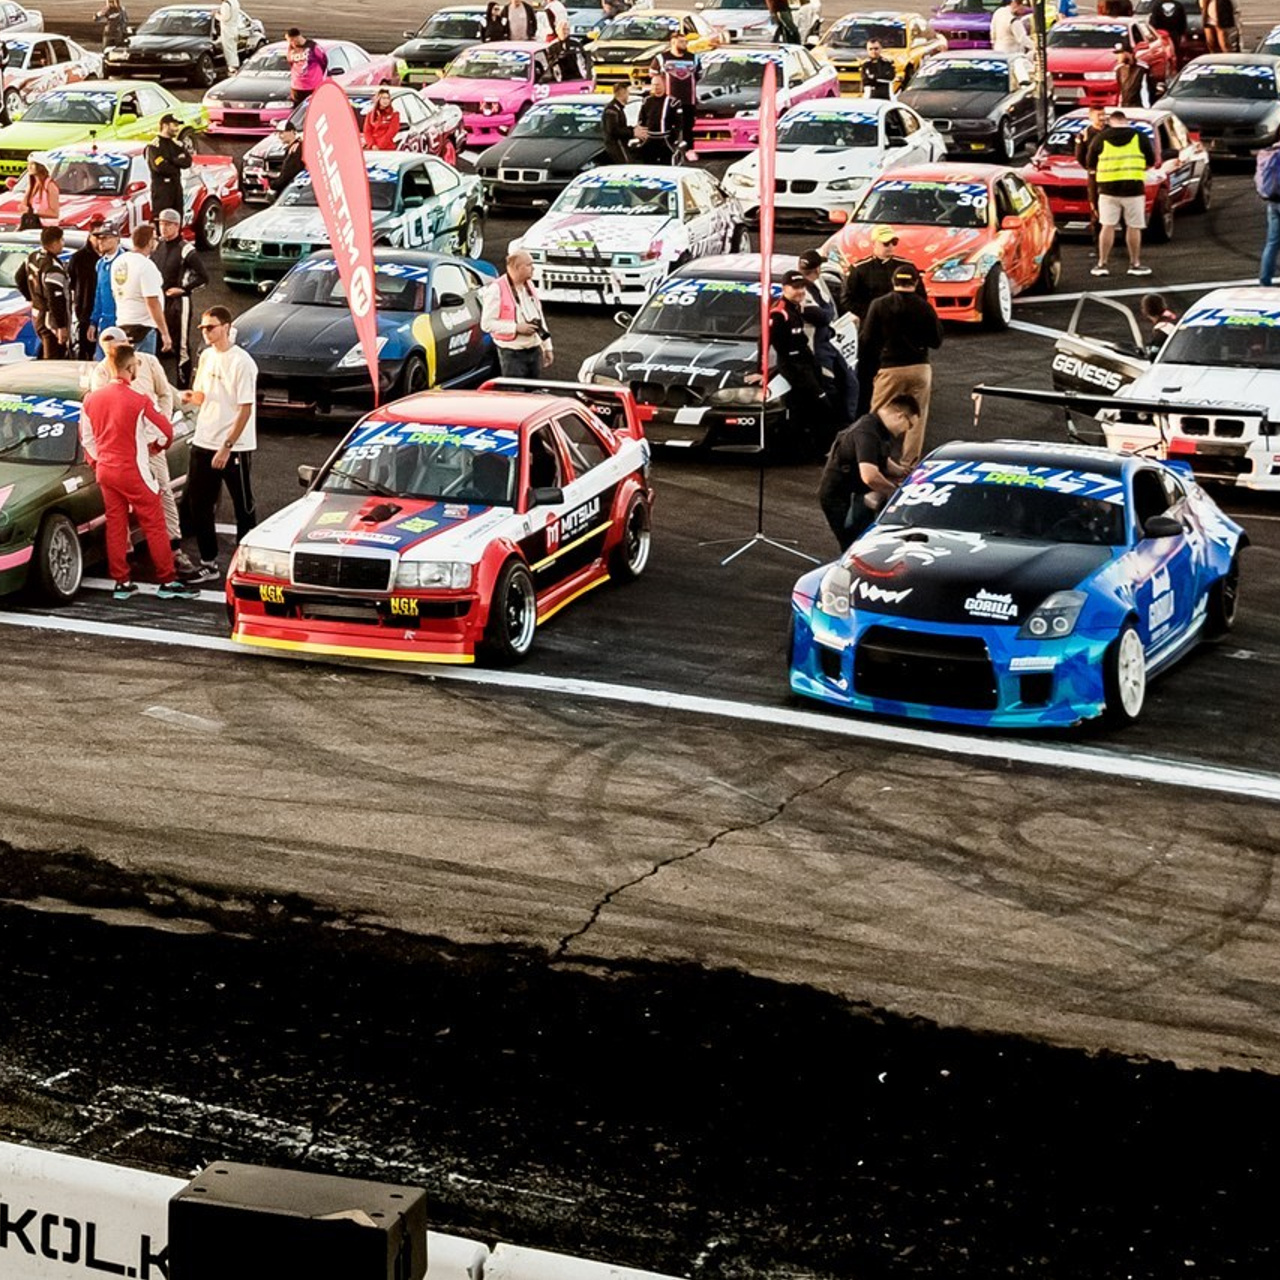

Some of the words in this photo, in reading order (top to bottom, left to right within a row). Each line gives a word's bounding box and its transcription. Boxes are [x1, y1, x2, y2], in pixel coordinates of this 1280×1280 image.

[1048, 132, 1071, 145] 02
[957, 192, 988, 208] 30
[663, 291, 698, 306] 66
[1052, 353, 1123, 390] GENESIS
[342, 445, 384, 461] 555
[897, 482, 952, 507] 194
[259, 584, 284, 599] NGK
[390, 597, 418, 610] NGK
[964, 598, 1018, 617] GORILLA
